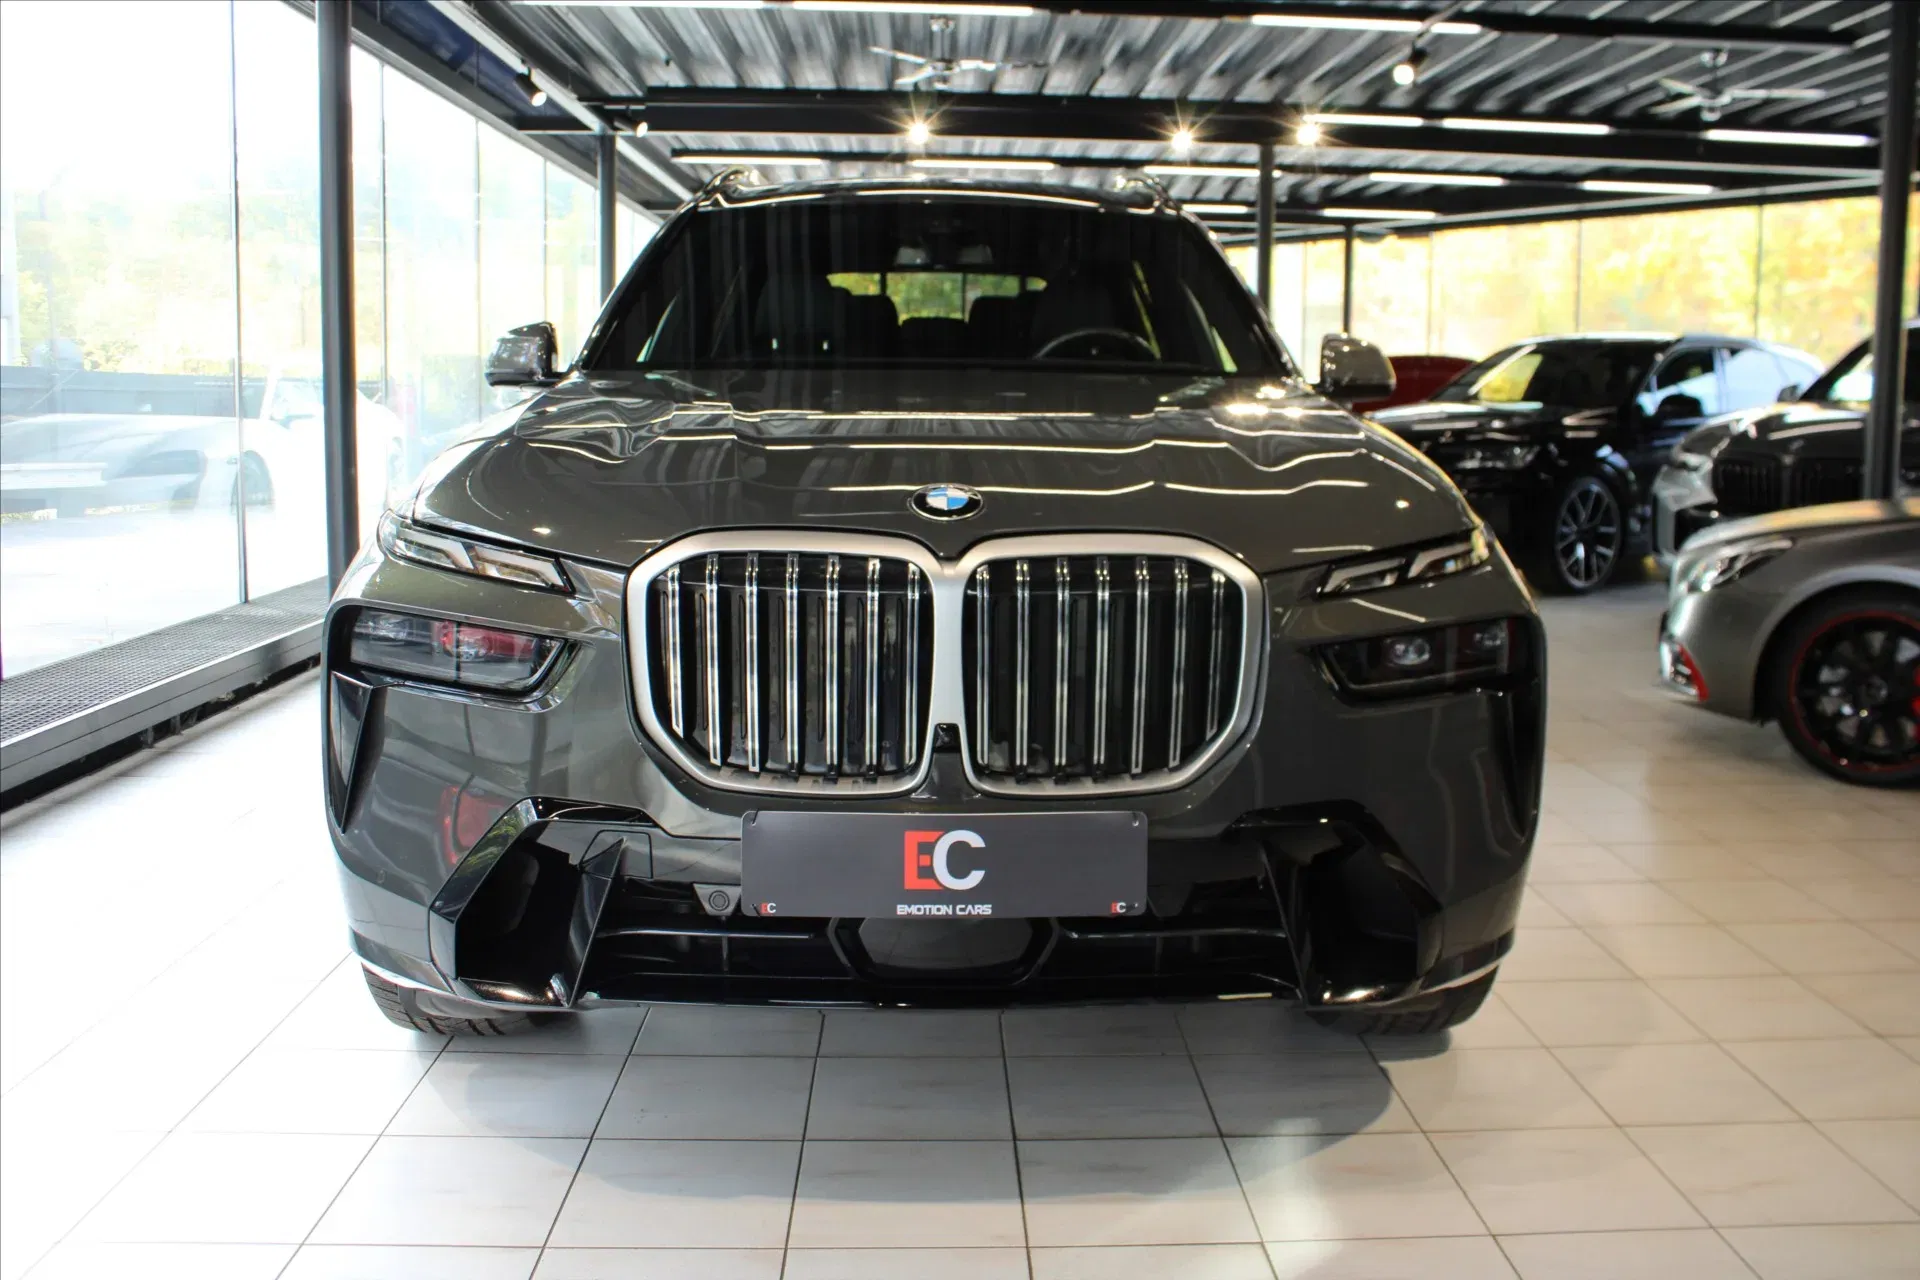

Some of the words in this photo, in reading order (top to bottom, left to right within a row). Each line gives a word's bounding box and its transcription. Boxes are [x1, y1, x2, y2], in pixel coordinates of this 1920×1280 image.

[904, 829, 986, 891] EC
[761, 902, 777, 914] EC
[896, 904, 953, 916] EMOTION
[956, 904, 993, 916] CARS
[1111, 902, 1127, 914] EC
